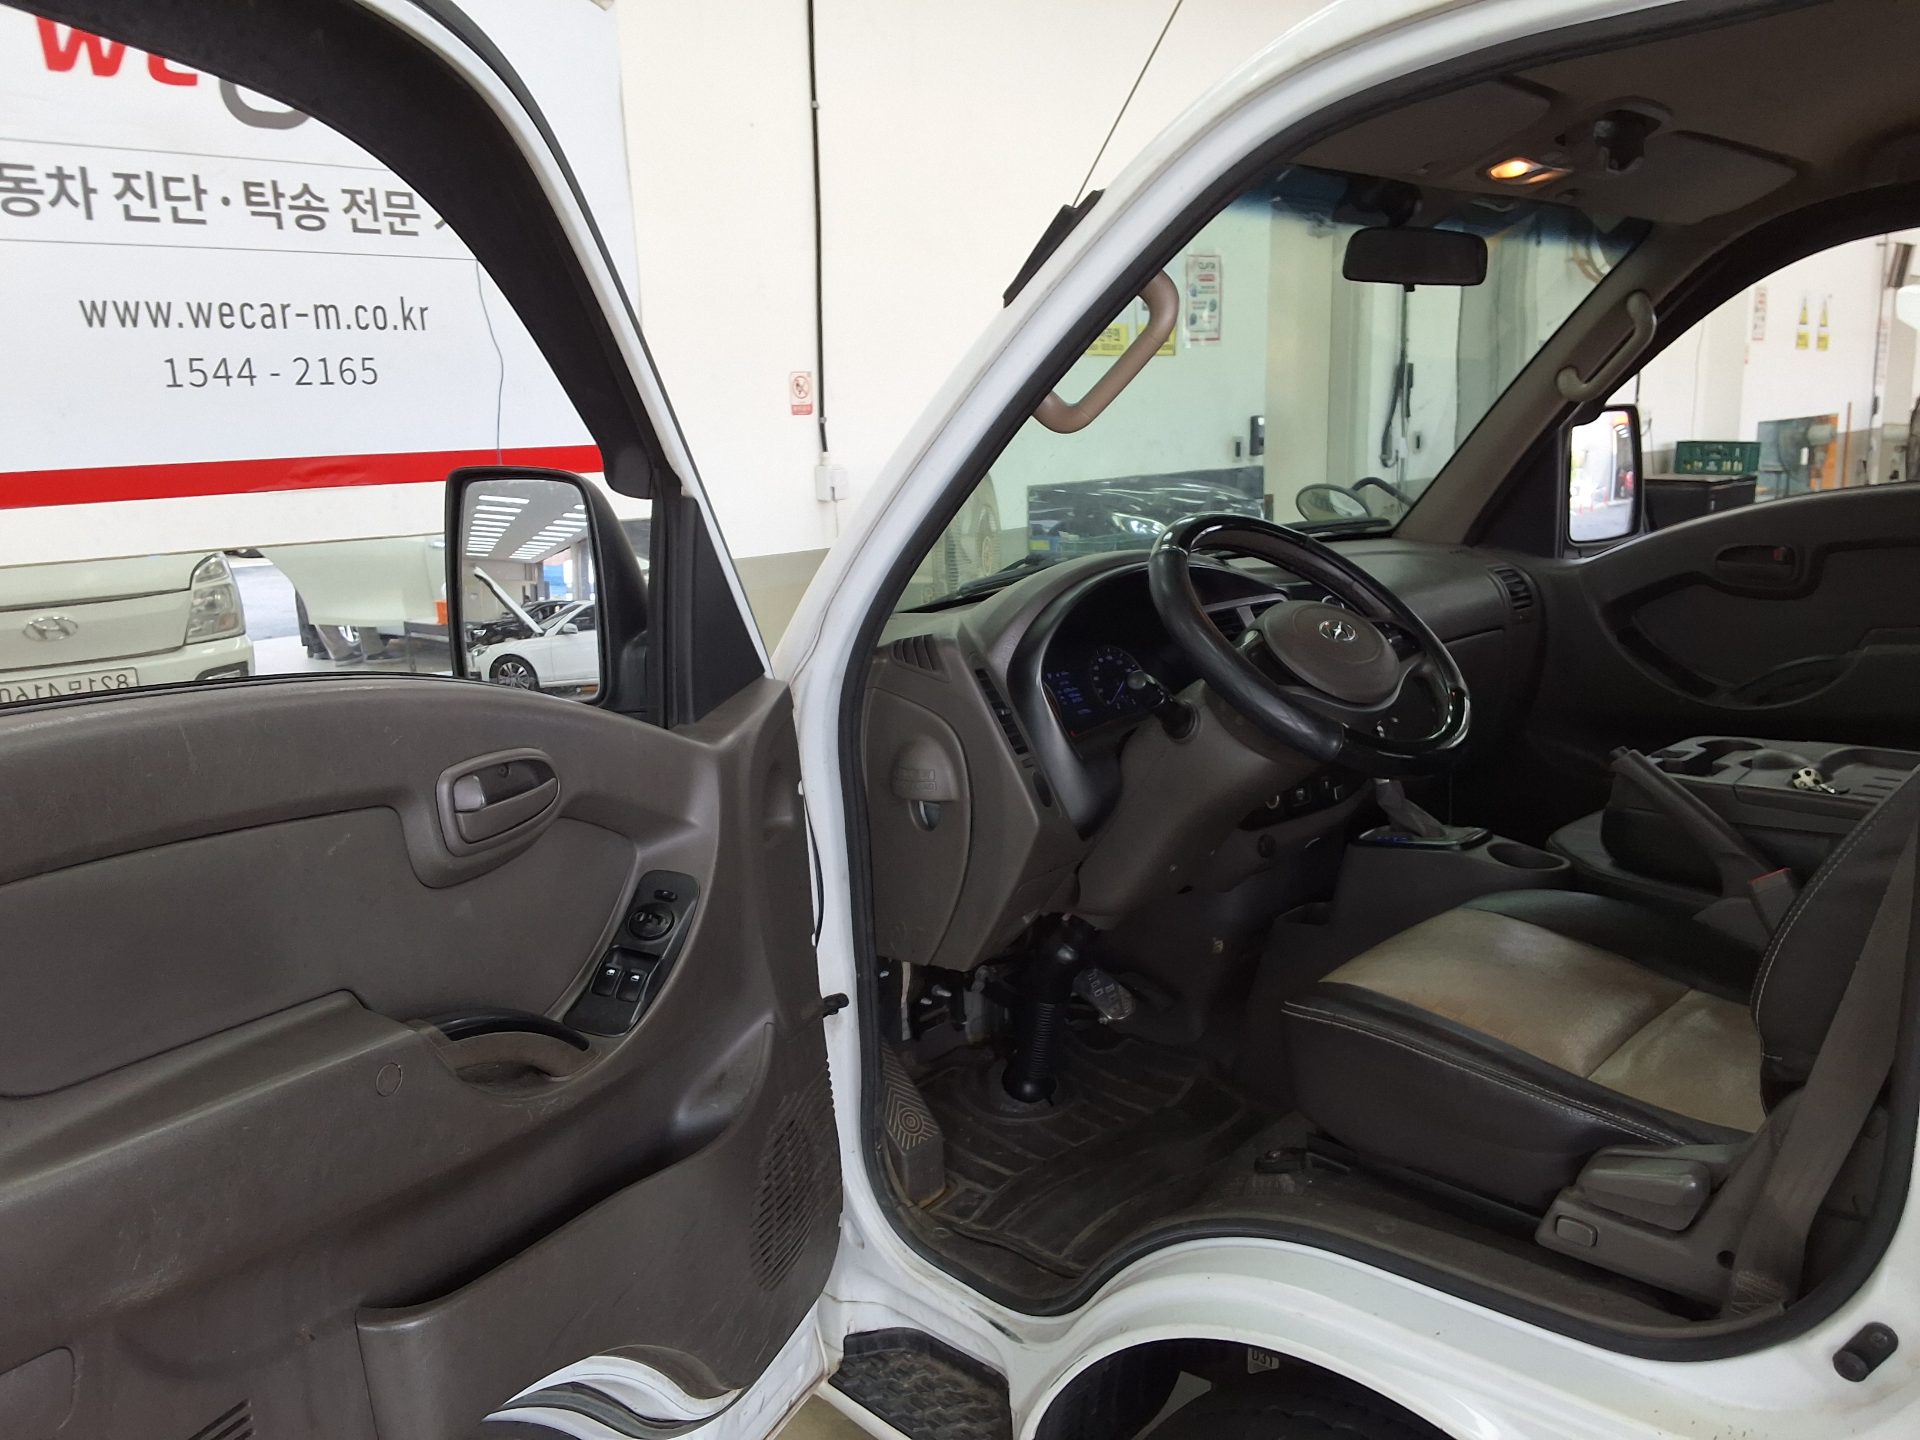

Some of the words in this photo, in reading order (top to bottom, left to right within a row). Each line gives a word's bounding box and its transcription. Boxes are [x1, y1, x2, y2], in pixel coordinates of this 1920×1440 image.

[341, 186, 421, 238] 전문
[79, 296, 430, 332] www.wecar-m.co.kr
[163, 357, 258, 389] 1544
[292, 357, 379, 387] 2165
